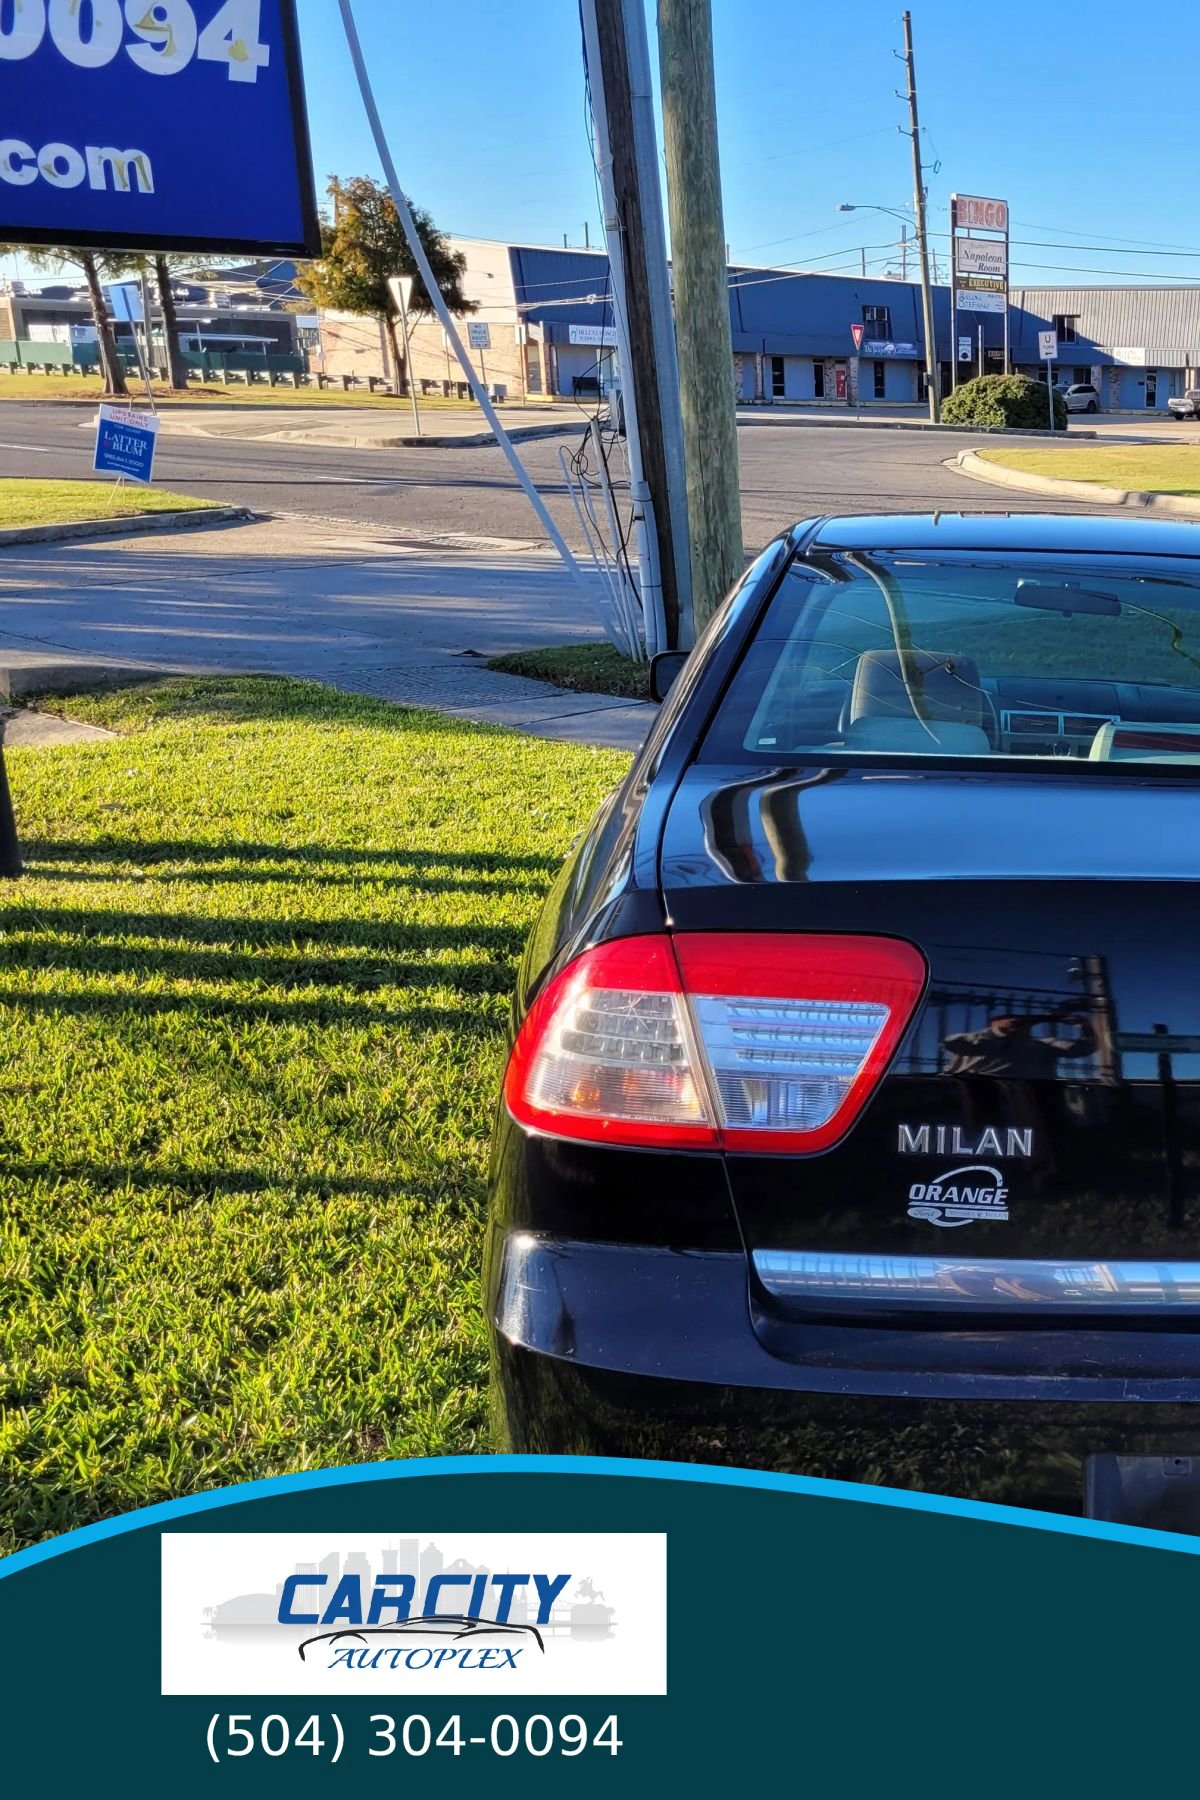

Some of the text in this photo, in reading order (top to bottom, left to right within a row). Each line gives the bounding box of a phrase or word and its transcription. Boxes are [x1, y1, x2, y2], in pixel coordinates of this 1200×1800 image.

[957, 199, 1006, 228] BINGO
[964, 250, 1003, 263] Napoleon
[977, 263, 1001, 273] Room
[1044, 334, 1051, 344] U
[129, 418, 149, 429] ONLY
[104, 430, 148, 450] LATTER
[112, 441, 143, 457] BLUM
[898, 1124, 1033, 1157] MILAN
[908, 1184, 1009, 1205] ORANGE
